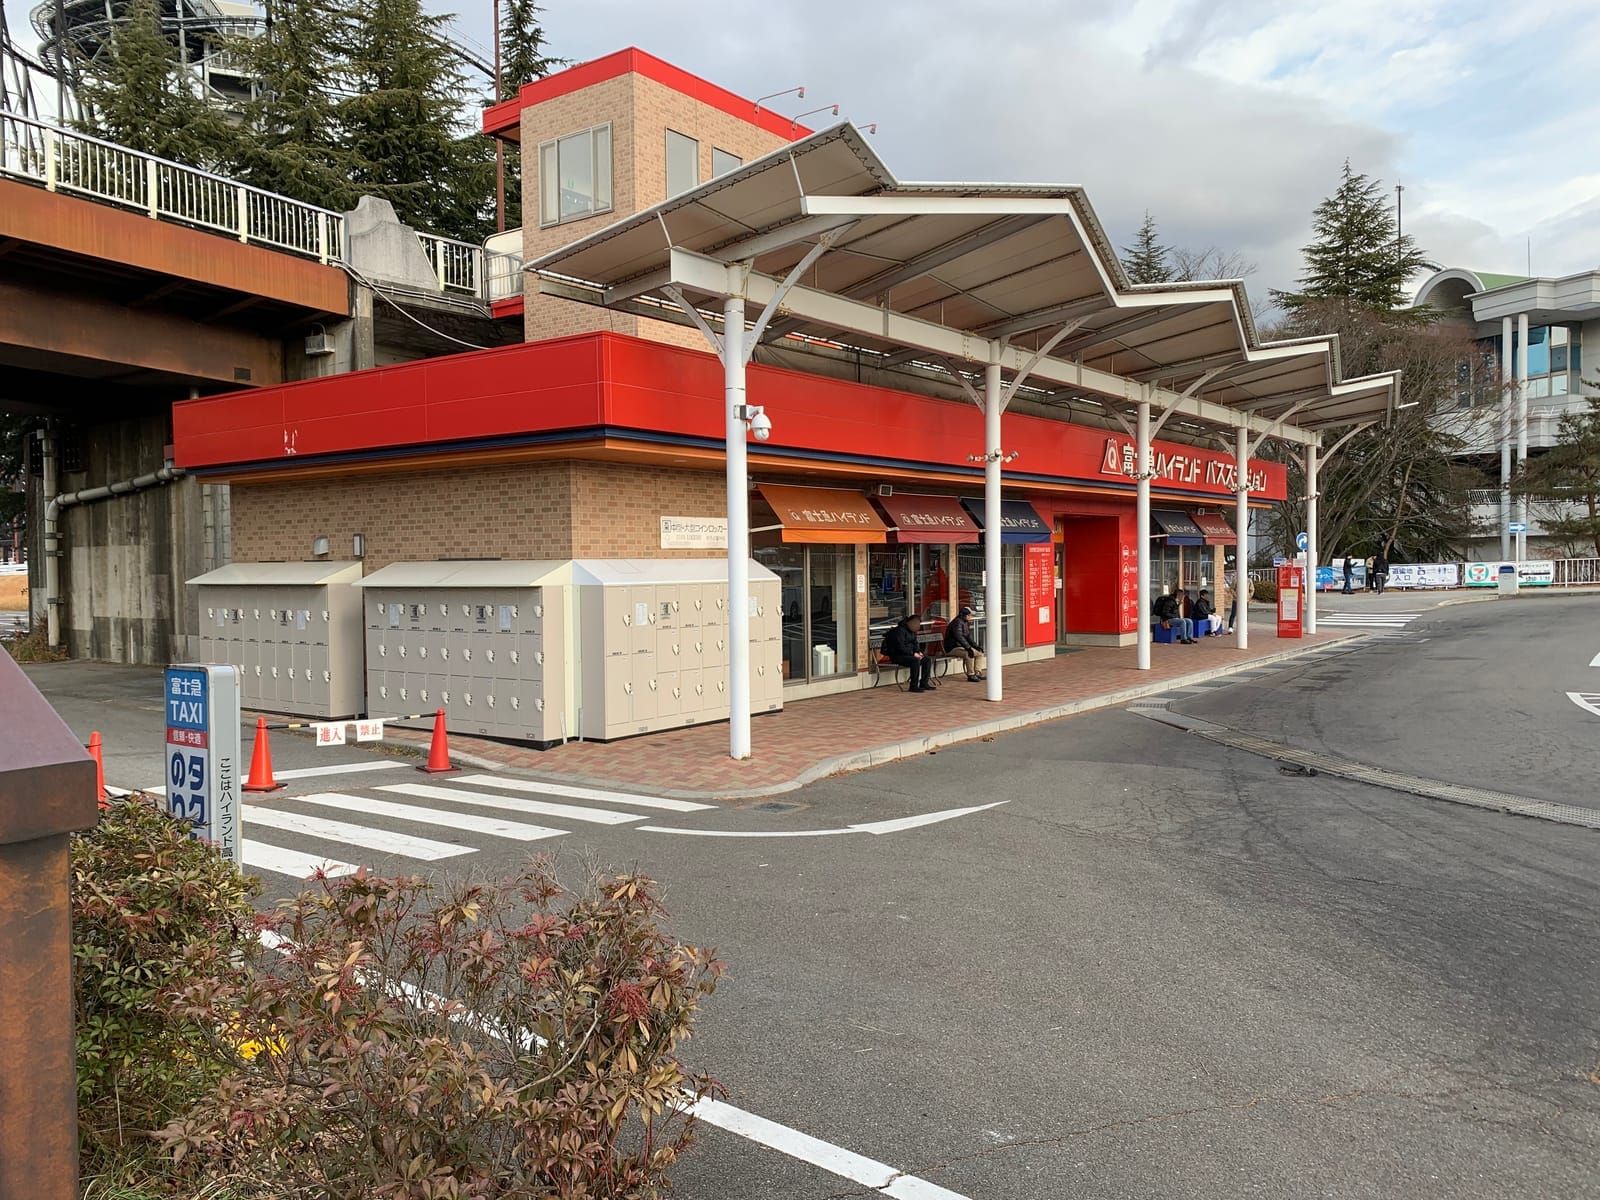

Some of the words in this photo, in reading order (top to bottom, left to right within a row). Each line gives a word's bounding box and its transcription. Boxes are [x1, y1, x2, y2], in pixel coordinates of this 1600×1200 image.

[1122, 442, 1201, 483] 富急ハイランド
[802, 509, 871, 524] 富士急ハイランド
[171, 677, 202, 697] 富士急
[170, 700, 203, 724] TAXI
[319, 726, 342, 743] 進入
[359, 723, 381, 737] 禁止
[219, 758, 234, 861] ここはハイランド高
